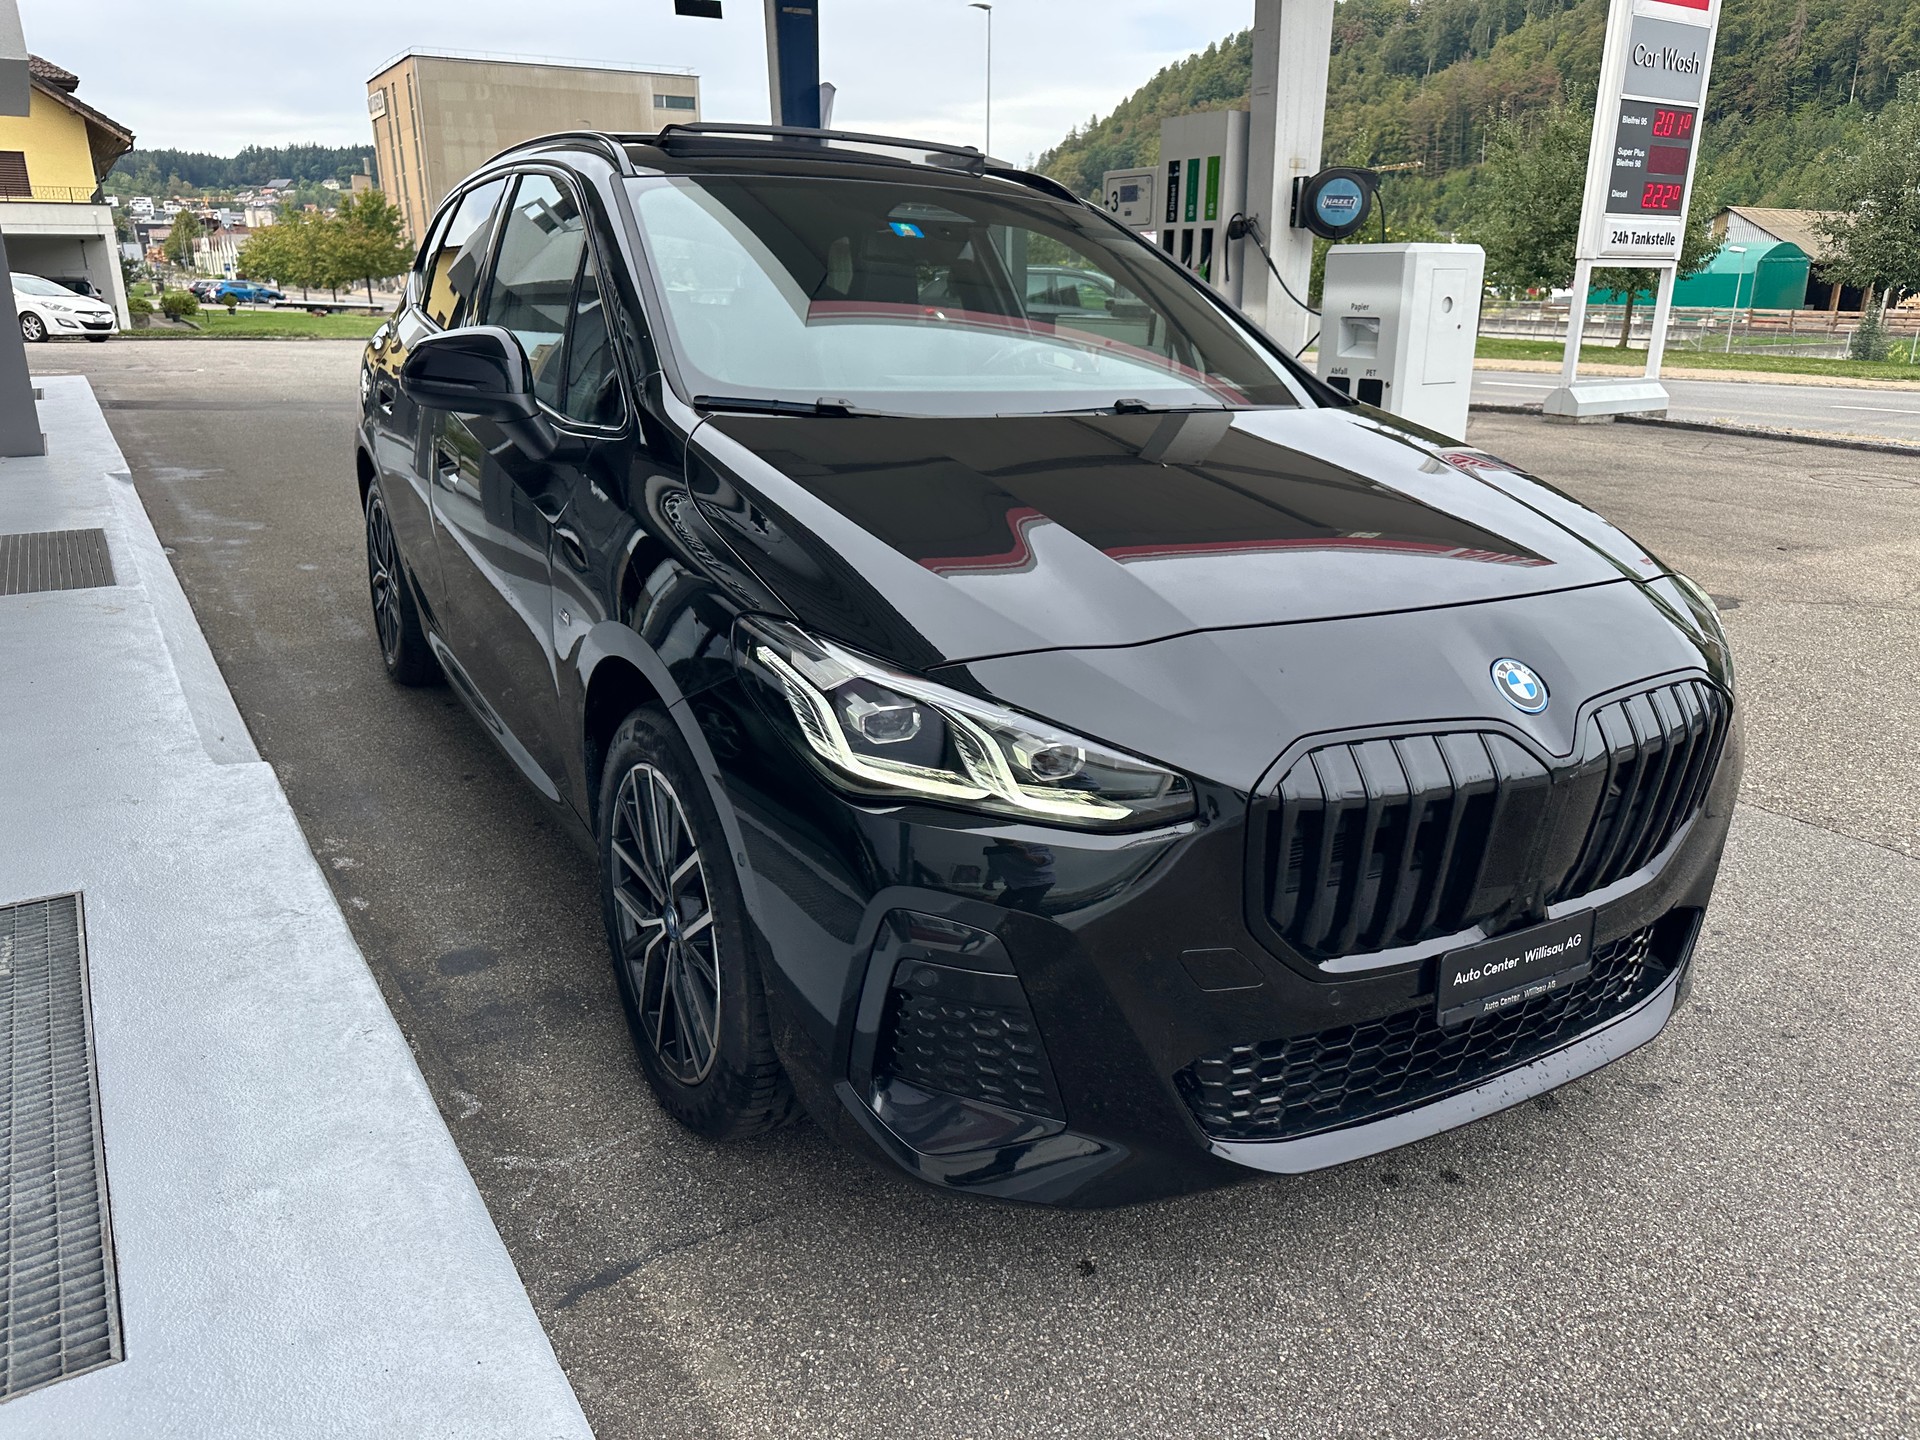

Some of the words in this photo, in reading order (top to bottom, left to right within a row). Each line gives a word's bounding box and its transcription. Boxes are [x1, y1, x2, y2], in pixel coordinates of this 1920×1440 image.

[1633, 42, 1660, 69] Car
[1663, 47, 1700, 75] Wash
[1622, 115, 1640, 125] Bleifrei
[1640, 117, 1647, 125] 95
[1617, 147, 1633, 157] Super
[1633, 148, 1645, 157] Plus
[1616, 158, 1634, 167] Bleifrei
[1634, 160, 1642, 168] 98
[1611, 189, 1628, 198] Diesel
[1111, 191, 1119, 213] 3
[1323, 196, 1356, 208] HAZET
[1611, 230, 1629, 245] 24h
[1630, 231, 1676, 247] Tankstelle
[1351, 303, 1369, 312] Papier
[1331, 367, 1348, 375] Abfall
[1497, 662, 1531, 679] BMW
[1453, 970, 1481, 987] Auto
[1483, 957, 1520, 976] Center
[1524, 941, 1564, 964] Willisau
[1565, 933, 1582, 951] AG
[1483, 1000, 1499, 1012] Auto
[1500, 993, 1520, 1006] Center
[1523, 984, 1547, 999] Willisau
[1547, 980, 1557, 992] AG
